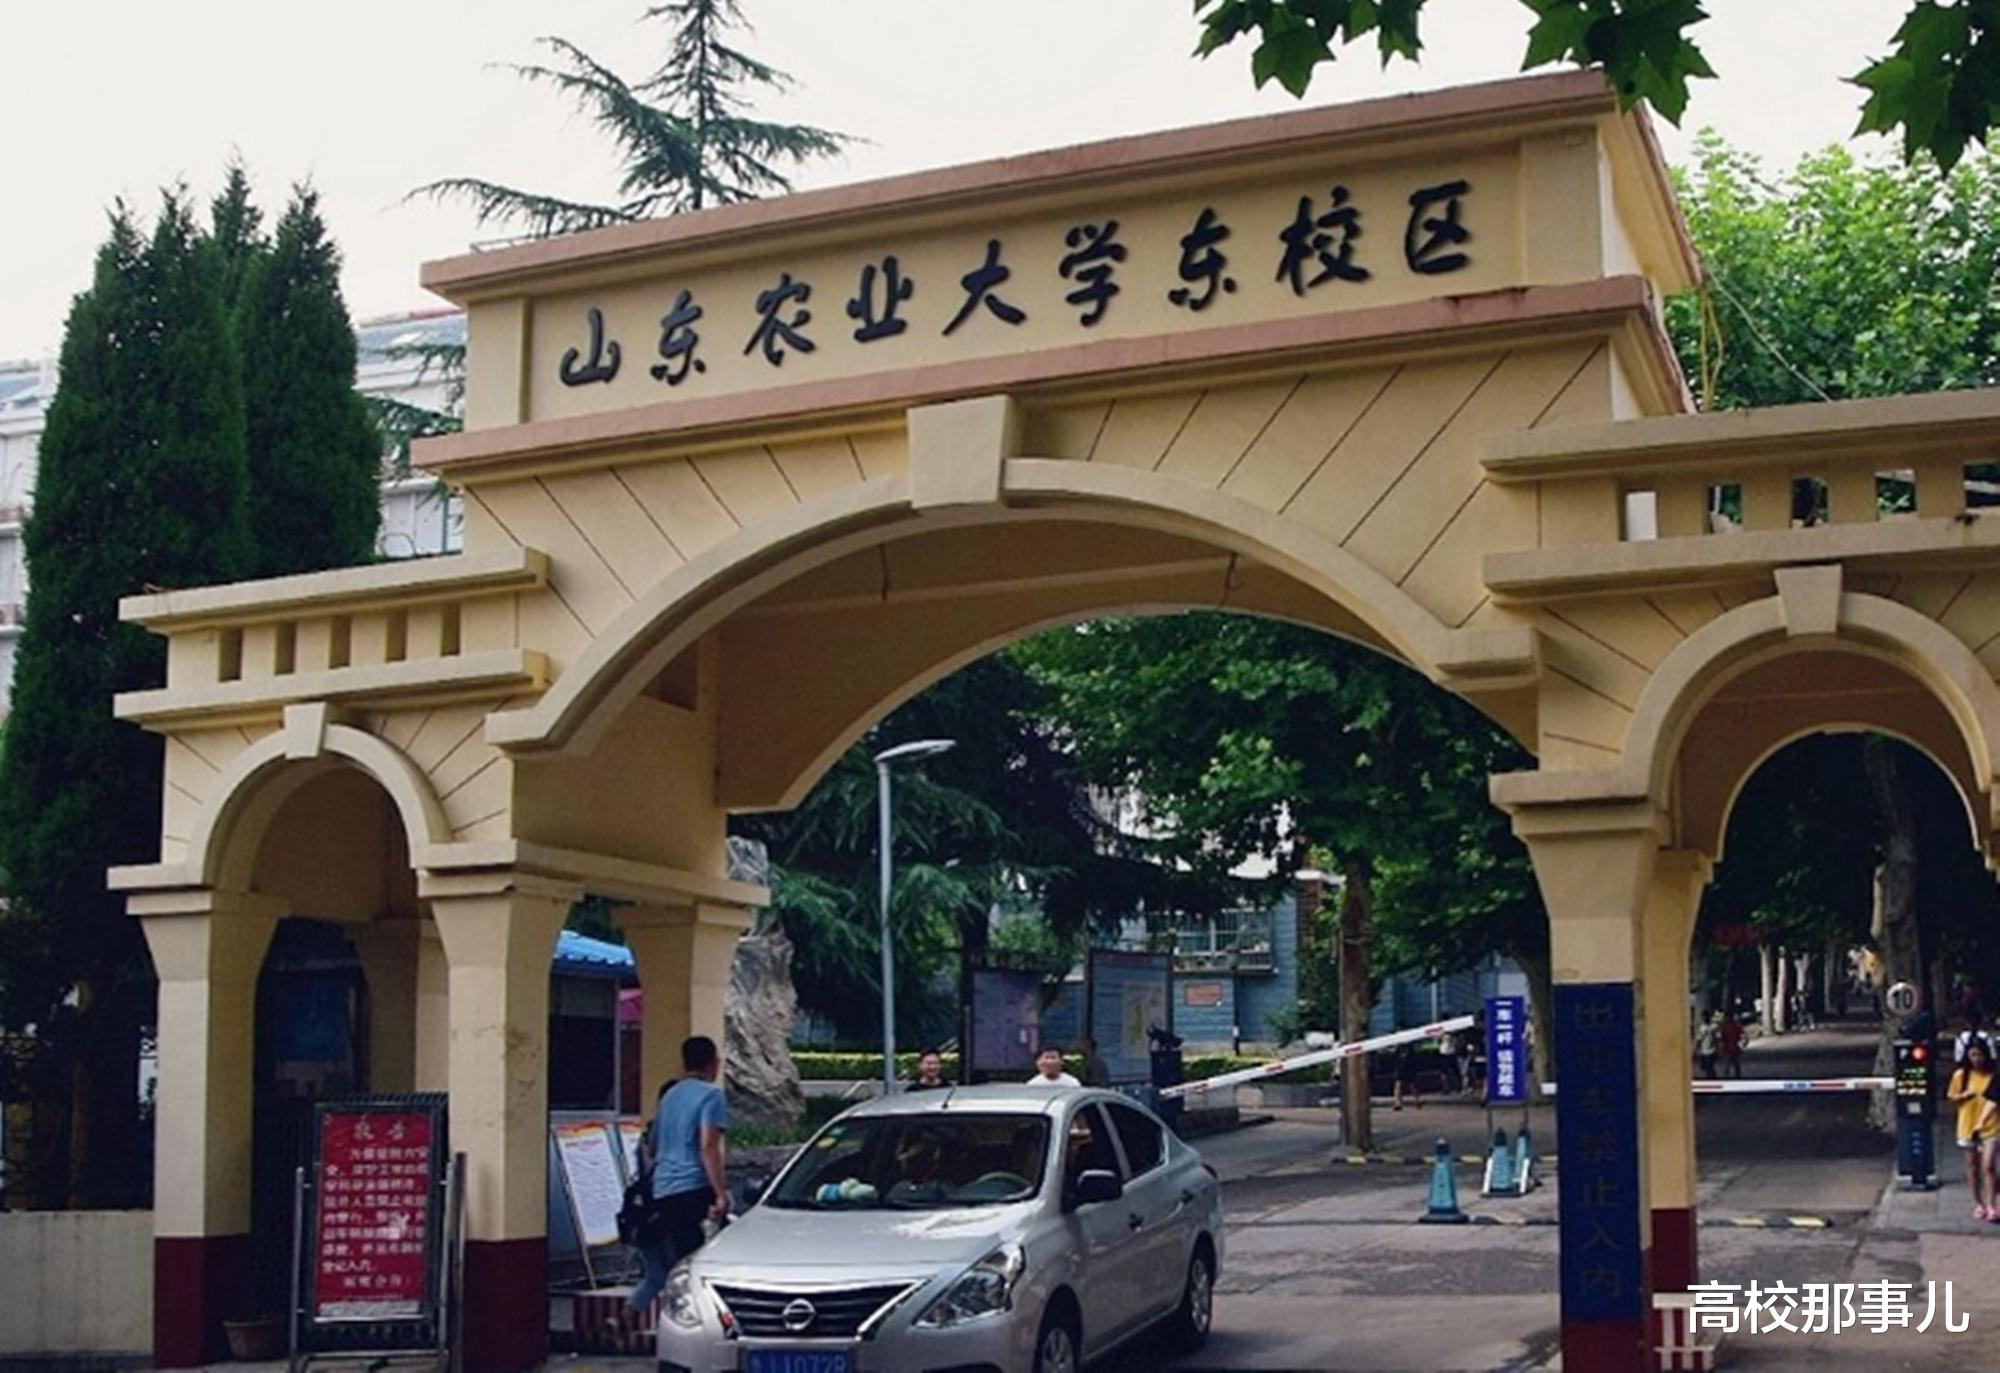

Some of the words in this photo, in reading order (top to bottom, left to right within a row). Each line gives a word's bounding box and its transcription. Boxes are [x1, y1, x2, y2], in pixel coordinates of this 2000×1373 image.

[557, 180, 1474, 388] 山东农业大学东校区
[1892, 990, 1912, 1009] 10
